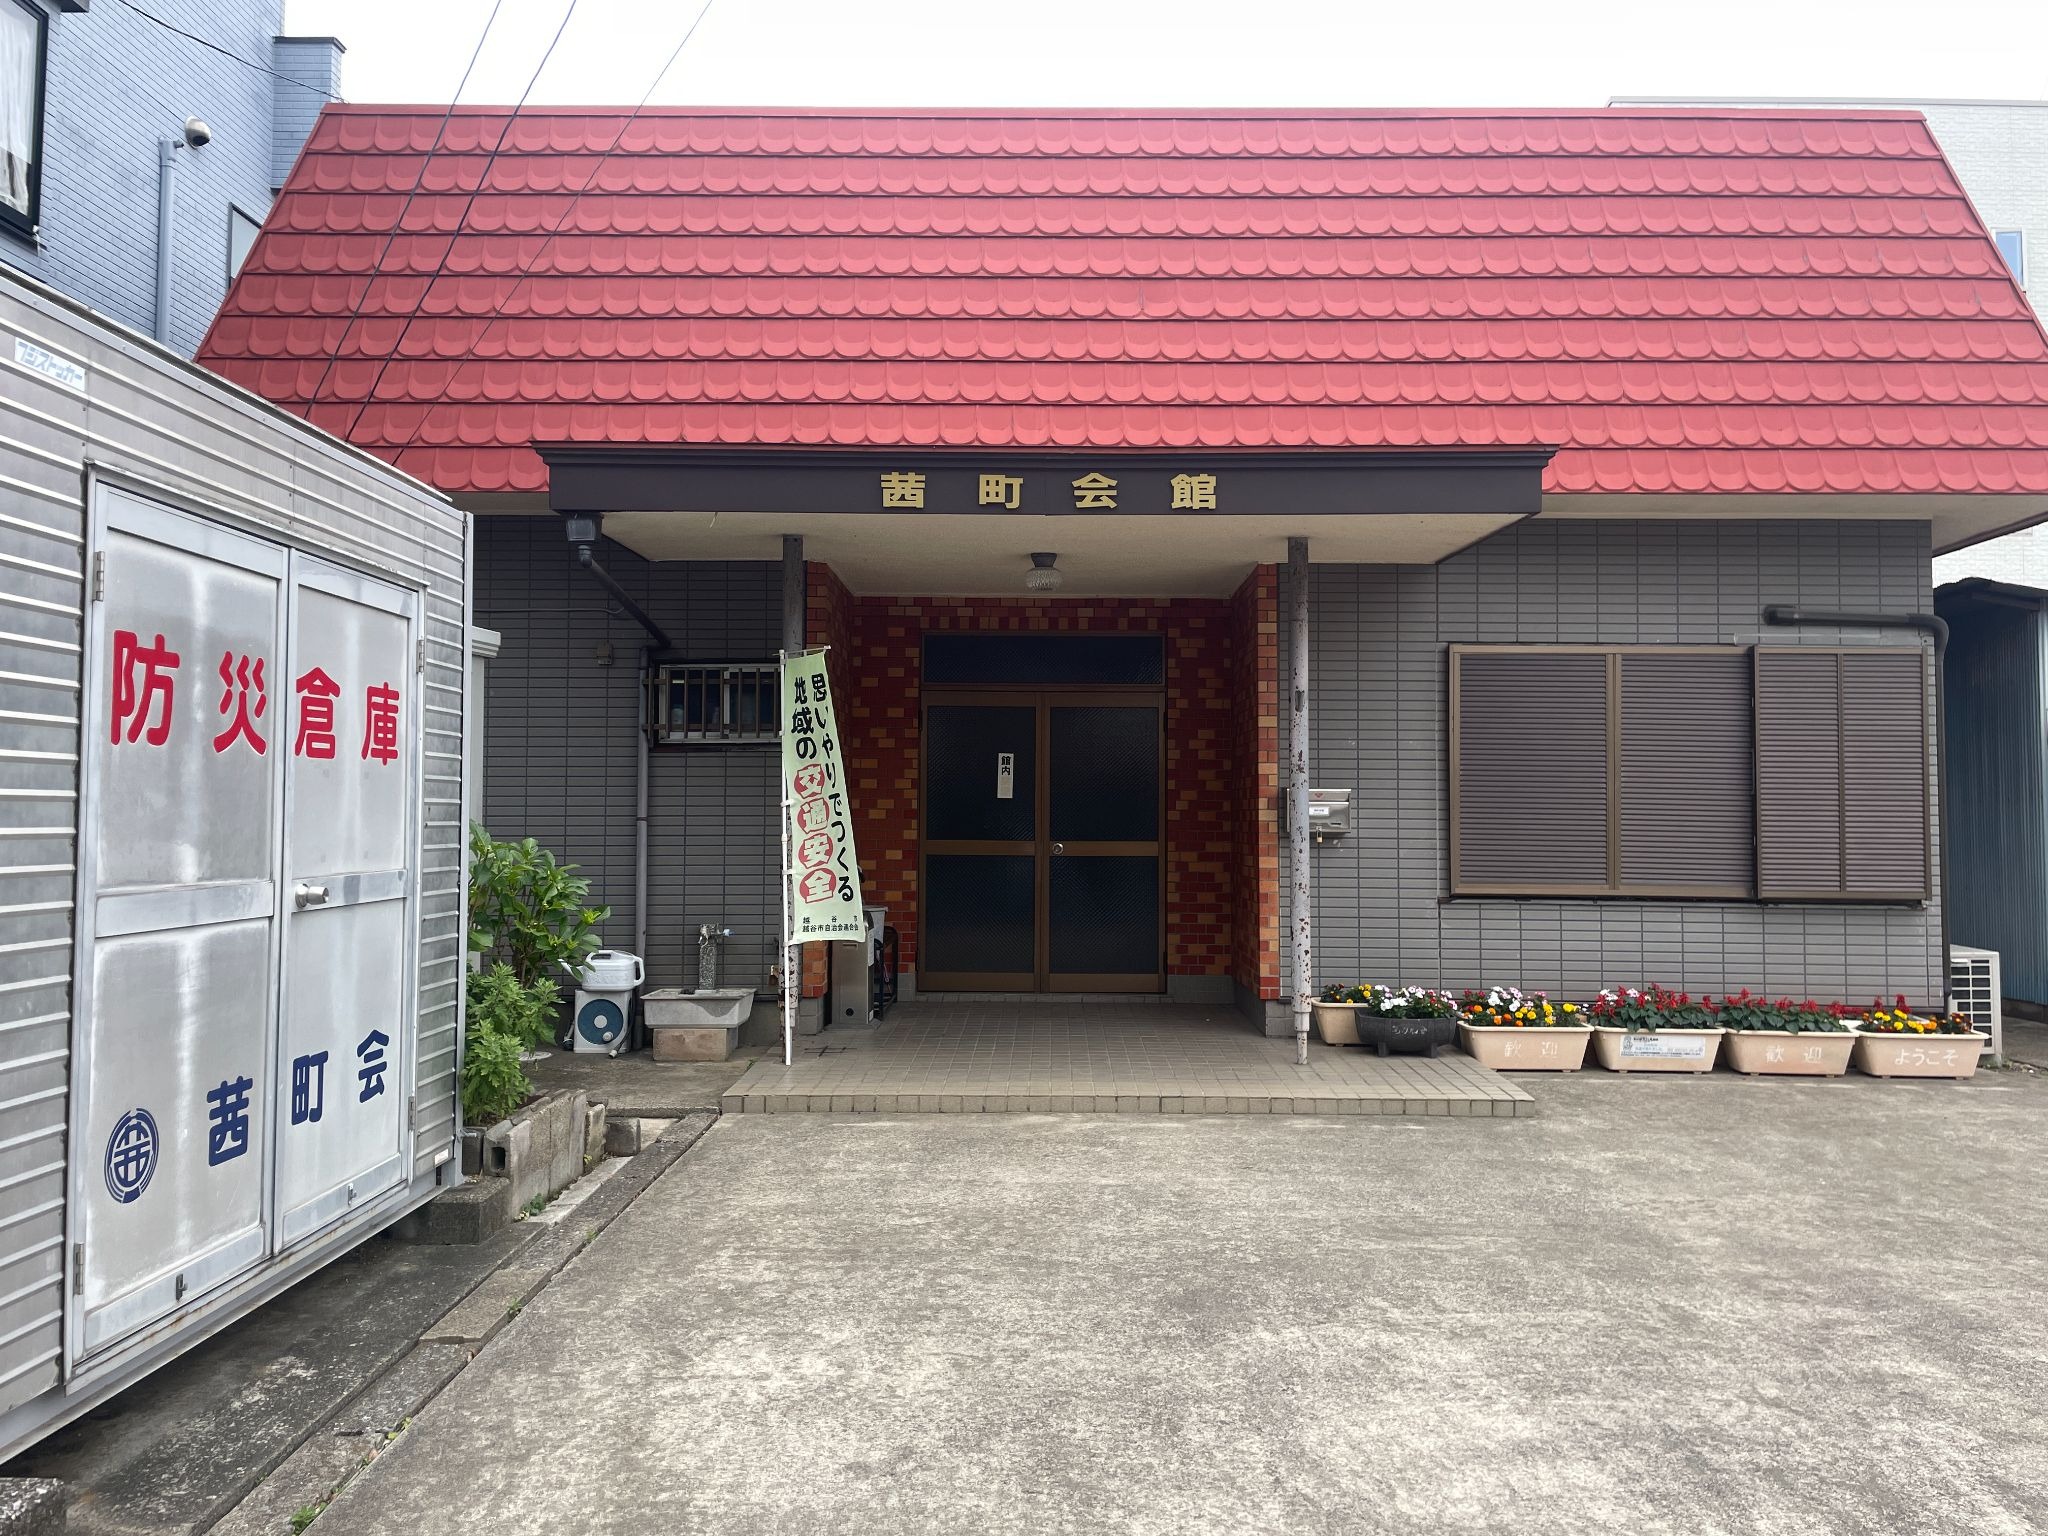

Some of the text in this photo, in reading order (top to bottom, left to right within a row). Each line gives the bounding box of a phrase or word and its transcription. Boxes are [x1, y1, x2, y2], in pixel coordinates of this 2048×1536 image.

[880, 472, 1216, 509] 茜町会館
[110, 630, 400, 766] 防災倉庫
[1001, 756, 1011, 775] 館内
[791, 676, 838, 903] 地域の交通安全
[811, 672, 854, 902] 思いやりでつくる
[1504, 1041, 1558, 1059] 歓迎
[1765, 1045, 1822, 1064] 歓迎
[1894, 1048, 1959, 1067] ようこそ
[206, 1029, 390, 1167] 茜町会
